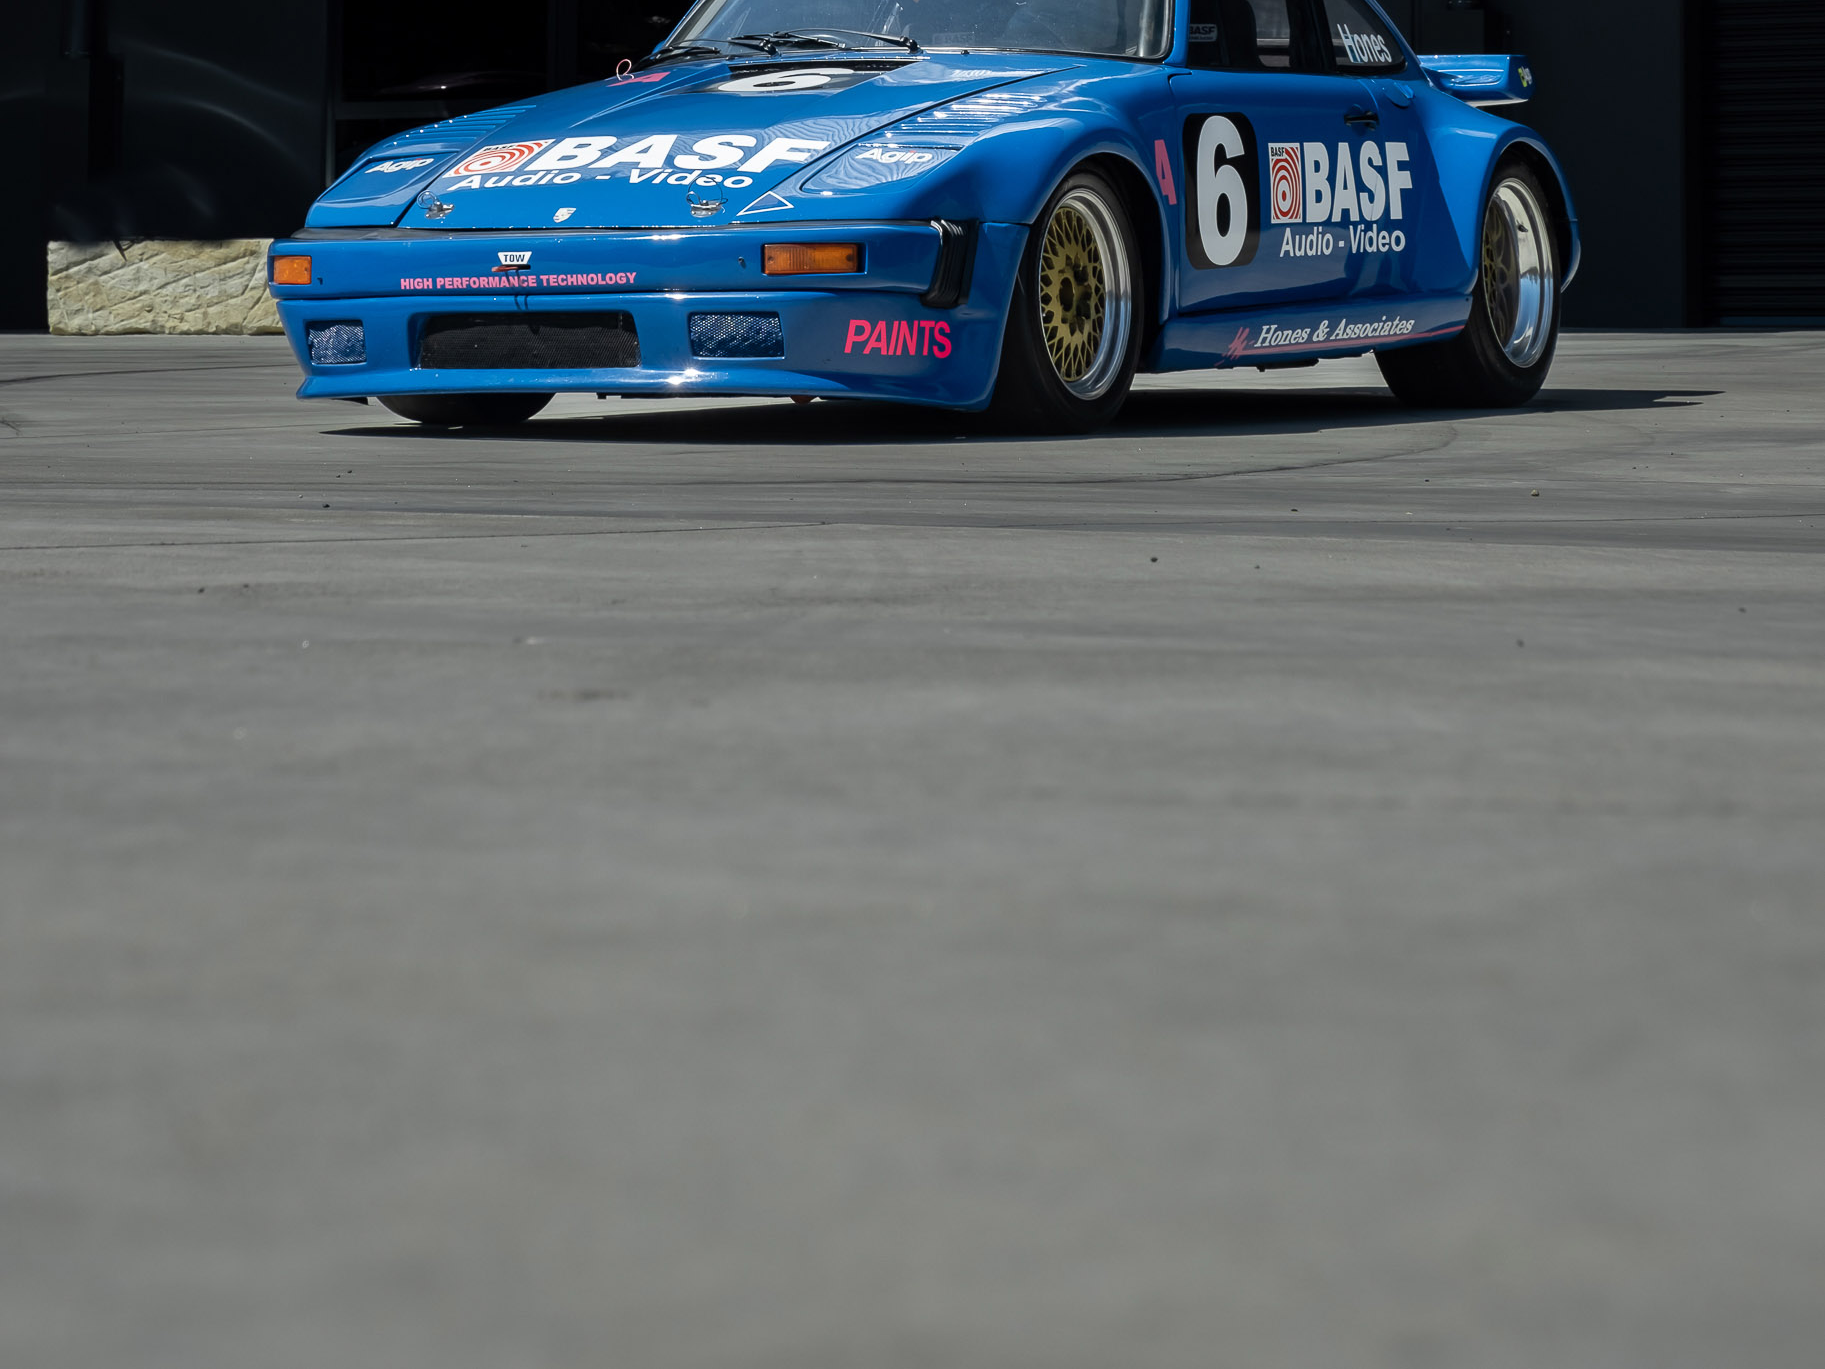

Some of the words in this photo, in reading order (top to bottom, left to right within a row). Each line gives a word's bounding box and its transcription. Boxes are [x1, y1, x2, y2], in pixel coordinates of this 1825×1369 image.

[1337, 24, 1392, 63] Hones
[717, 69, 853, 91] 6
[524, 134, 831, 172] BASF
[855, 148, 933, 164] Agip
[1270, 146, 1285, 157] BASF
[446, 170, 582, 191] Audio
[629, 169, 753, 188] Video
[1196, 115, 1248, 266] 6
[1303, 141, 1413, 223] BASF
[1280, 227, 1333, 258] Audio
[1350, 224, 1406, 253] Video
[503, 253, 526, 263] TOW
[400, 278, 433, 290] HIGH
[436, 275, 537, 289] PERFORMANCE
[540, 272, 637, 286] TECHNOLOGY
[844, 319, 952, 359] PAINTS
[1254, 324, 1310, 347] Hones
[1313, 319, 1329, 342] &
[1330, 315, 1416, 340] Associates
